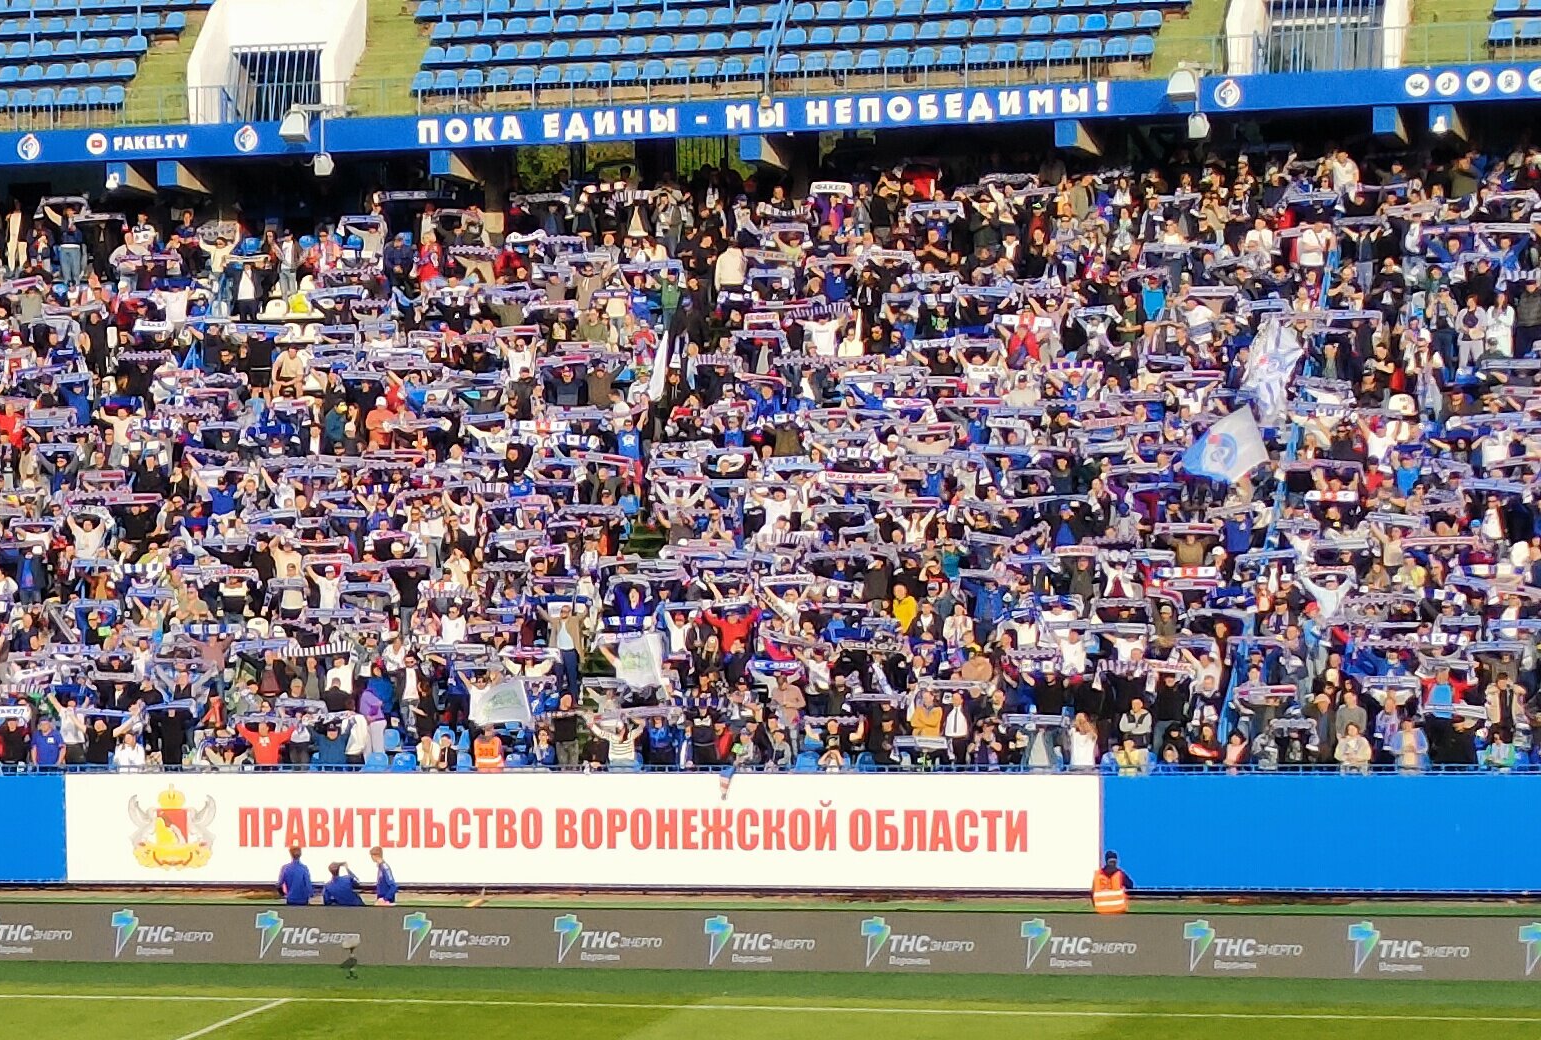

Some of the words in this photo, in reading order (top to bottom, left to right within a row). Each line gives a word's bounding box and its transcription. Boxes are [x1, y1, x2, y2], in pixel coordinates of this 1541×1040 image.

[418, 116, 522, 143] ПОКА
[544, 109, 676, 142] ЕДИНЫ
[726, 102, 784, 129] МЫ
[806, 82, 1107, 128] НЕПОБЕДИМЫ!
[114, 134, 187, 151] FAKELTV
[239, 807, 542, 850] ПРАВИТЕЛЬСТВО
[556, 800, 836, 852] ВОРОНЕЖСКОЙ
[850, 809, 1027, 852] ОБЛАСТИ
